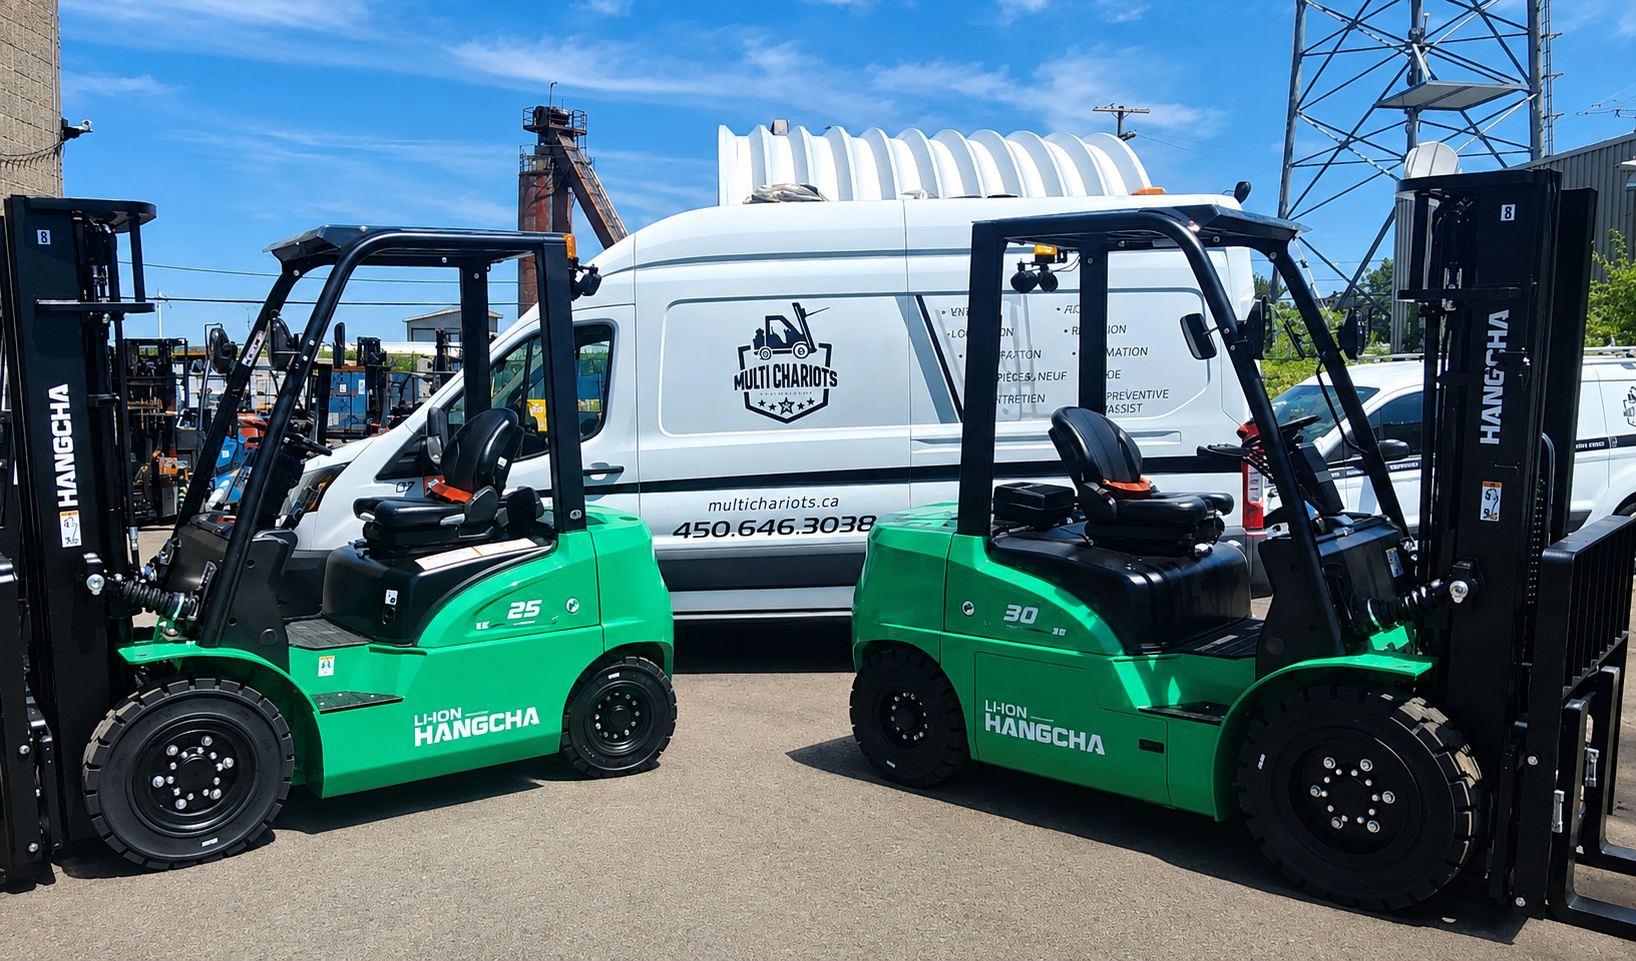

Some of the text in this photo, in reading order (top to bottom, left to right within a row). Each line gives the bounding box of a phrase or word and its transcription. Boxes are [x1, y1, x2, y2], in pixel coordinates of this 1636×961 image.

[1504, 205, 1513, 220] 8
[40, 230, 48, 244] 8
[733, 363, 838, 391] MULTI CHARIOTS
[1038, 371, 1067, 382] NEUF
[1479, 309, 1510, 445] HANGCHA
[1106, 403, 1143, 414] ASSIST
[48, 383, 79, 507] HANGCHA
[709, 495, 839, 512] multichariots.ca
[672, 515, 876, 539] 450.646.3038
[507, 599, 542, 619] 25
[1003, 603, 1039, 625] 30
[414, 706, 462, 726] LI-ION
[985, 699, 1027, 719] LI-ION
[414, 706, 540, 747] HANGCHA
[985, 712, 1106, 755] HANGCHA
